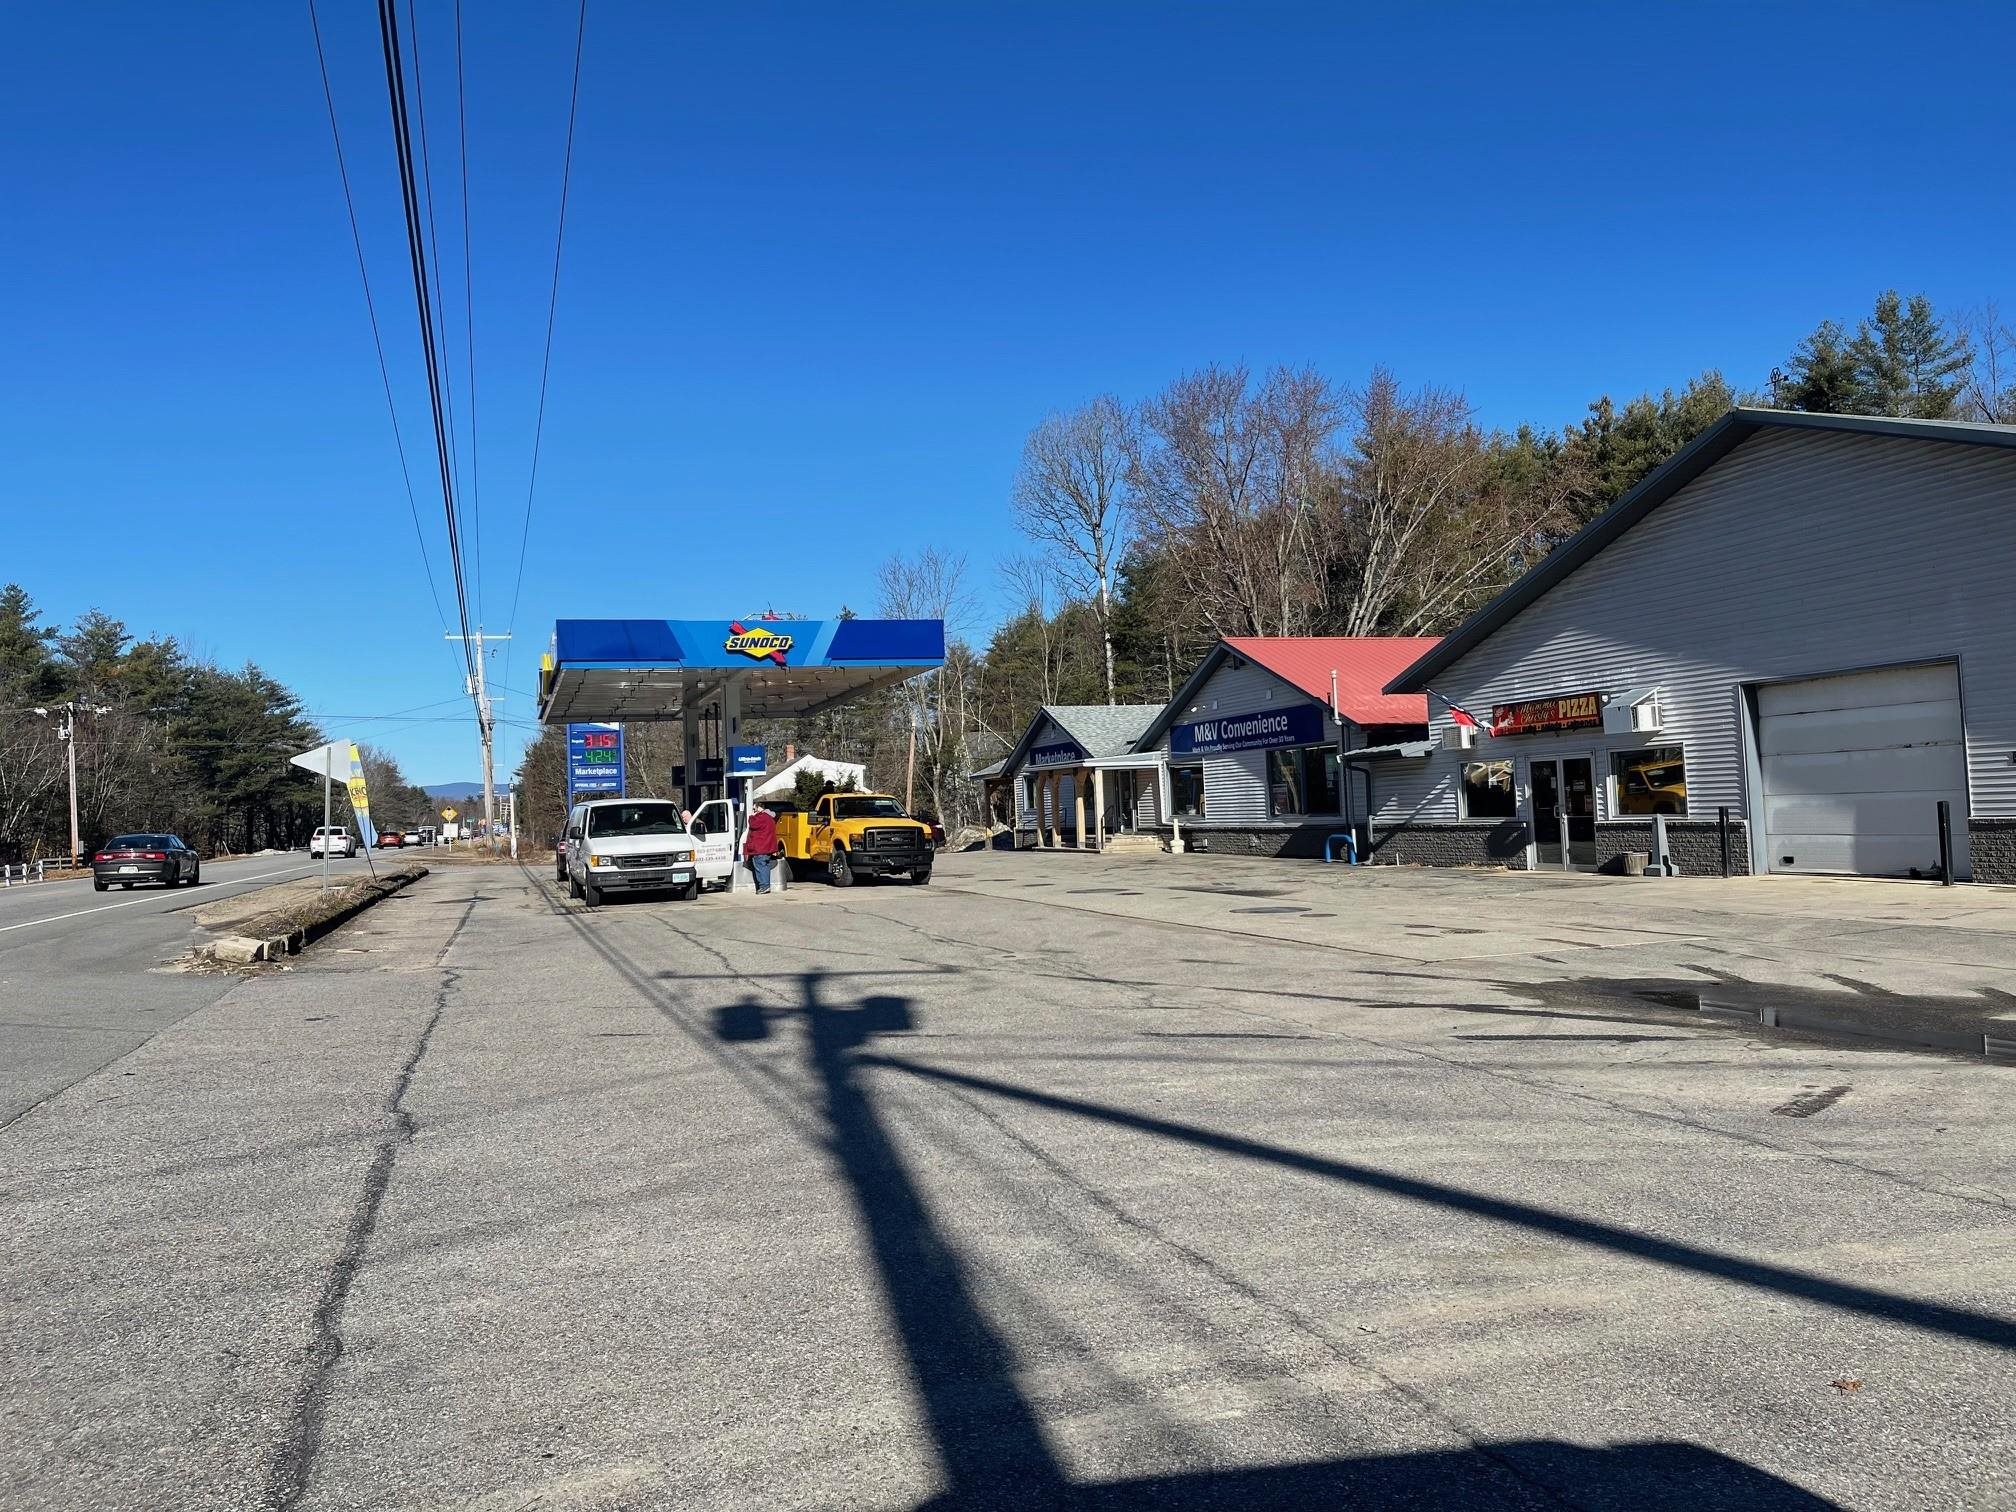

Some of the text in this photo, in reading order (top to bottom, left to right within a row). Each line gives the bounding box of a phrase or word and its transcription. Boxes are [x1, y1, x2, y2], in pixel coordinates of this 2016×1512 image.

[729, 637, 790, 648] SUNOCO
[1558, 697, 1597, 719] PIZZA
[1194, 714, 1288, 743] M&V Convenience
[1222, 742, 1235, 750] Serving
[1242, 739, 1262, 748] Community
[1284, 735, 1295, 743] Years
[575, 768, 617, 777] Marketplace
